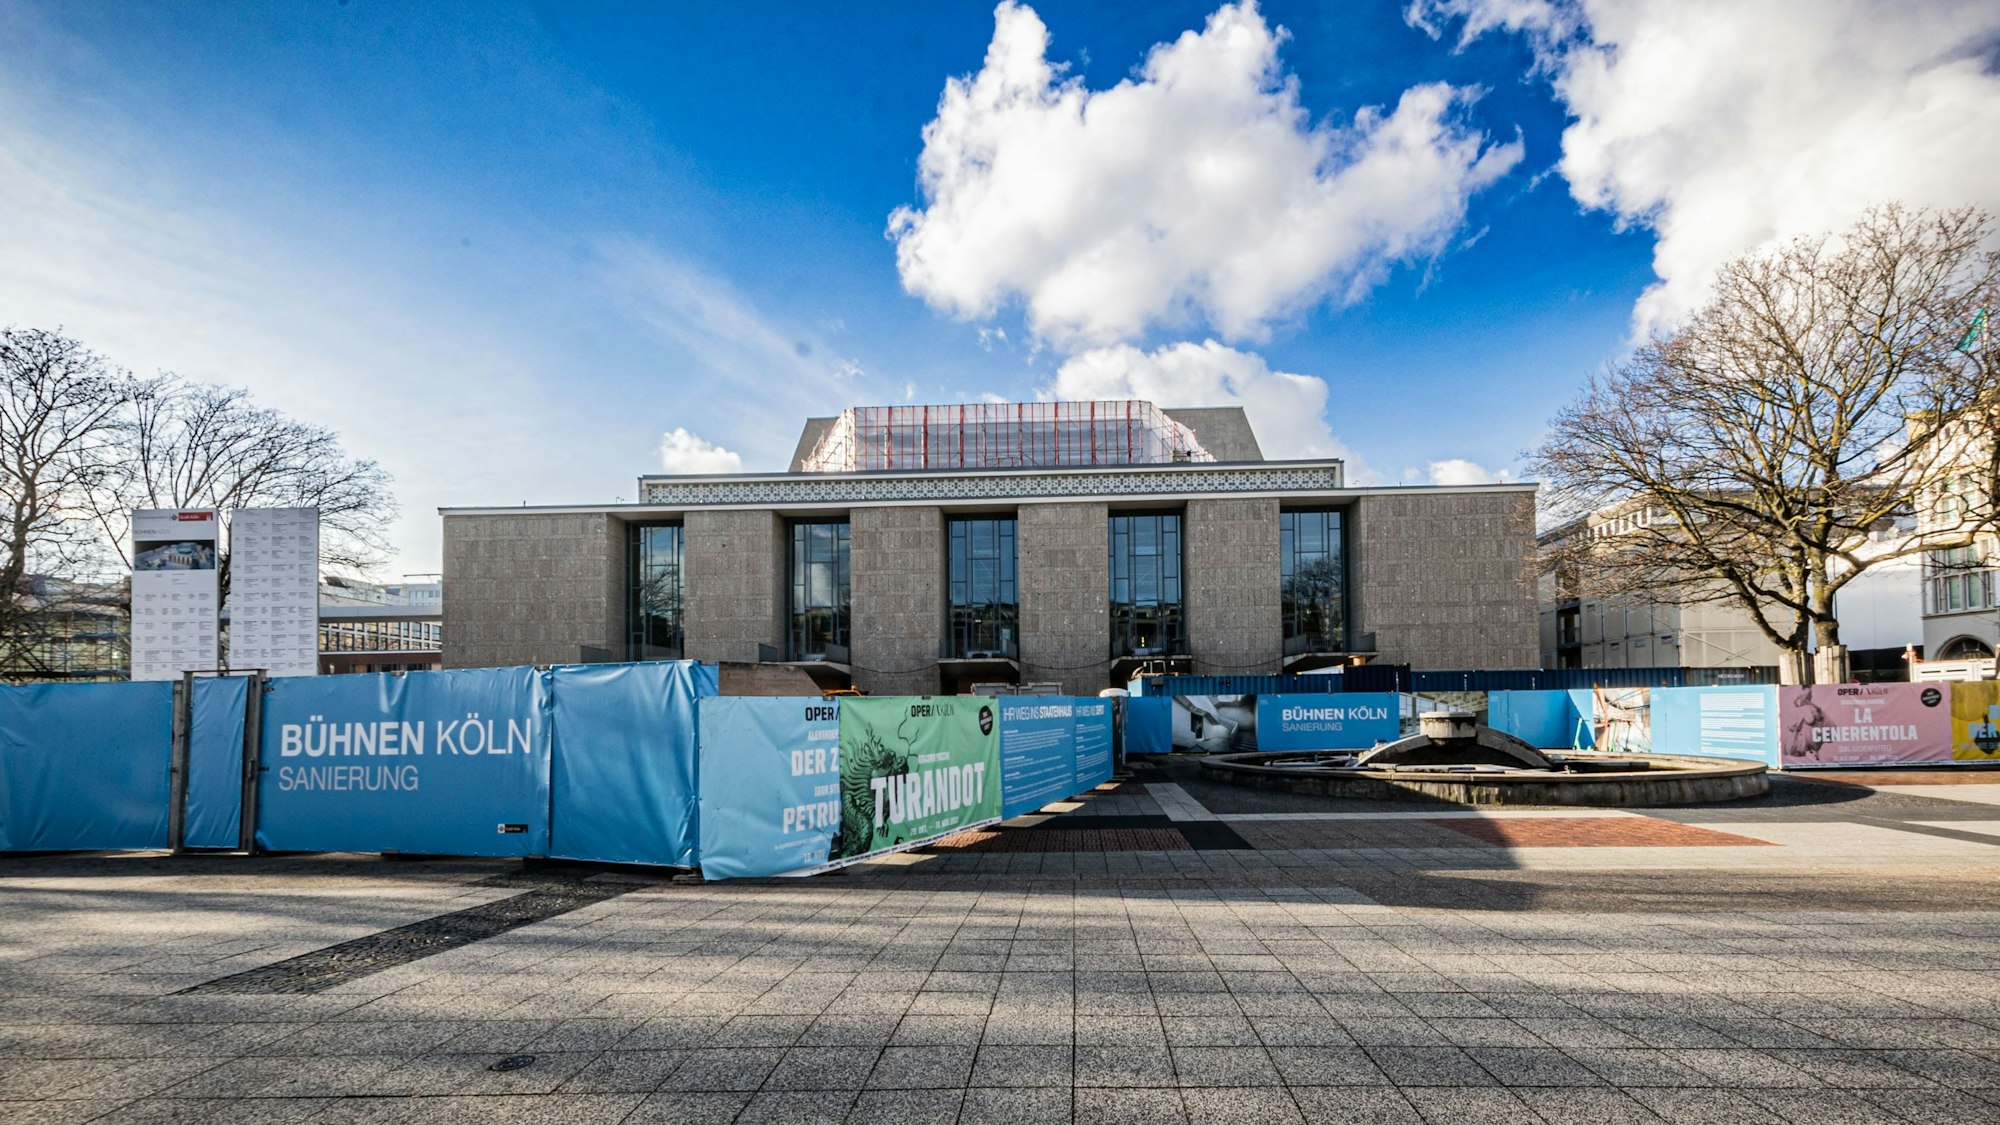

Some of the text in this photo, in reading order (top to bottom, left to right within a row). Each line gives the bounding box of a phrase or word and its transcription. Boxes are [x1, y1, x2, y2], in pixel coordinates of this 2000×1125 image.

[1838, 688, 1859, 696] OPER
[805, 706, 834, 721] OPER
[911, 705, 931, 717] OPER
[1040, 705, 1072, 719] STAATENHAUS
[1282, 706, 1388, 721] BÜHNEN KÖLN
[1854, 708, 1873, 723] LA
[1282, 722, 1343, 732] SANIERUNG
[1812, 725, 1918, 742] CENERENTOLA
[280, 713, 532, 757] BÜHNEN KÖLN
[791, 748, 826, 776] DER
[278, 765, 419, 791] SANIERUNG
[870, 762, 984, 828] TURANDOT
